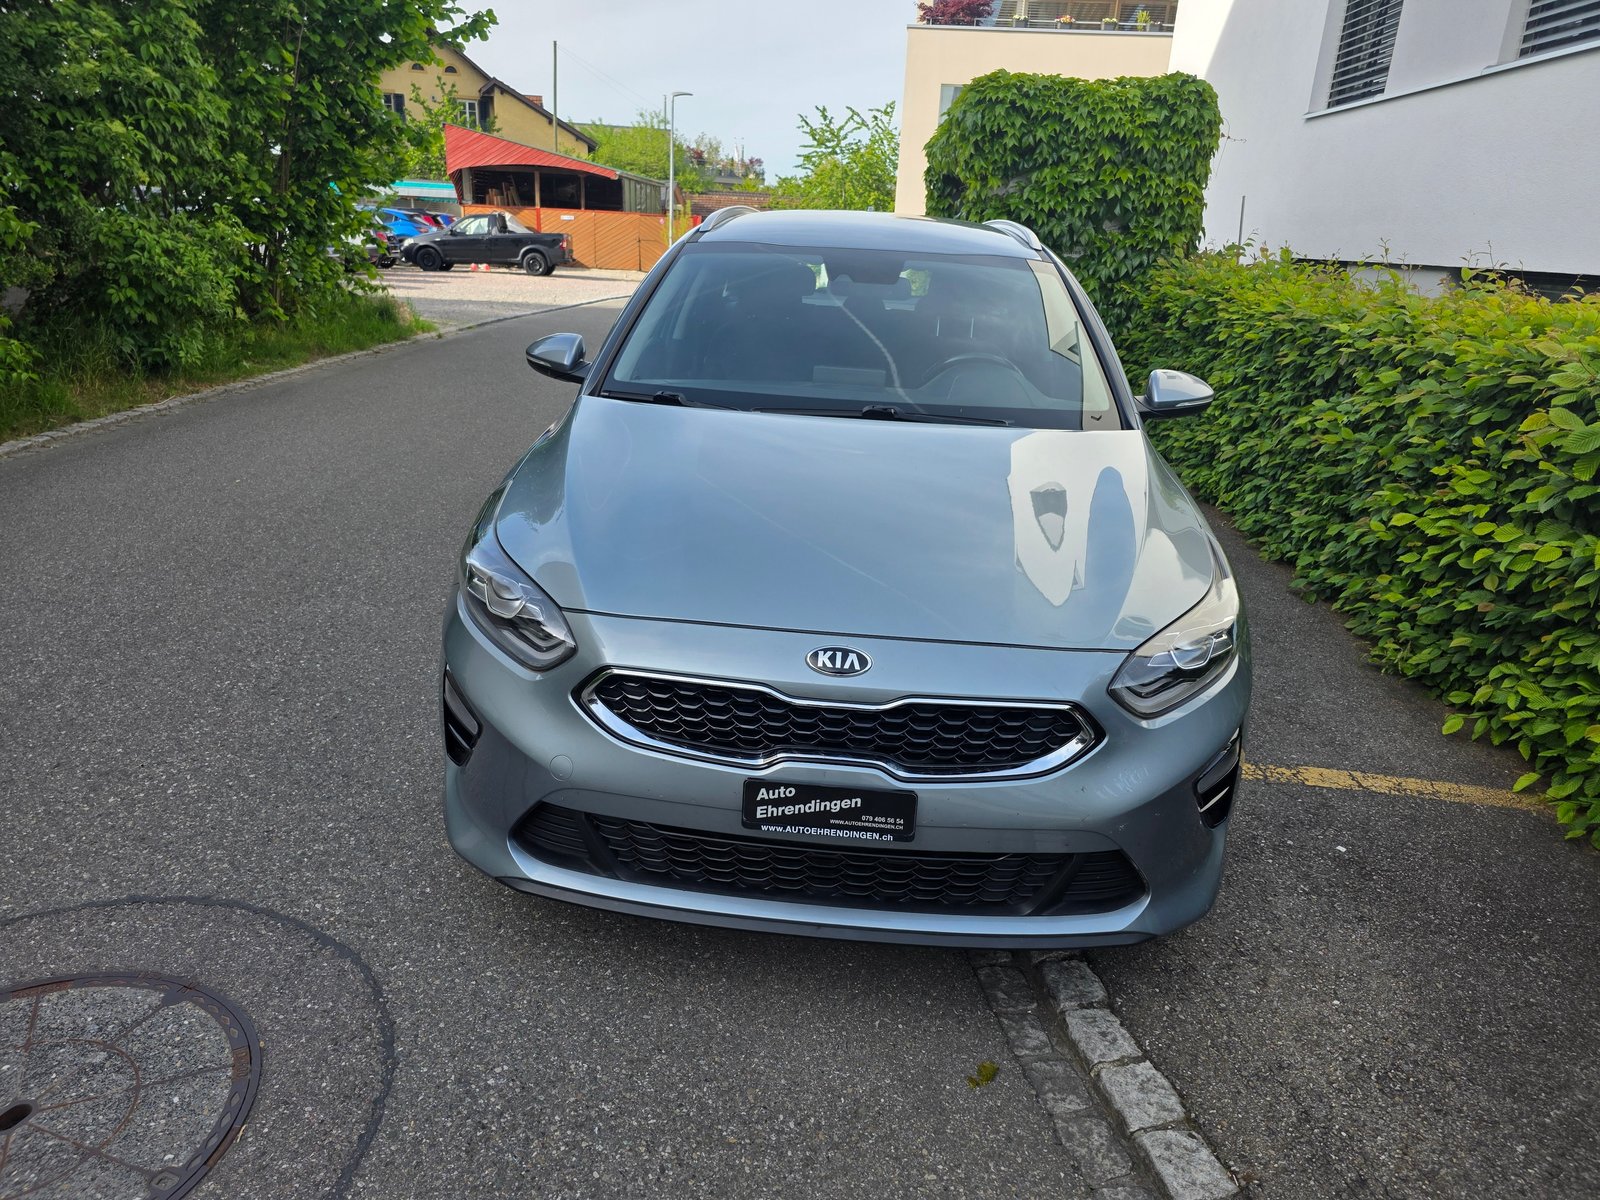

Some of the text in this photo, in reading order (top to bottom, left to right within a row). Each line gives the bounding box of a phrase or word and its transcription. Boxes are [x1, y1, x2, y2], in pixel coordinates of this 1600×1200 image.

[817, 650, 860, 671] KIA
[756, 786, 796, 801] Auto
[756, 797, 862, 819] Ehrendingen
